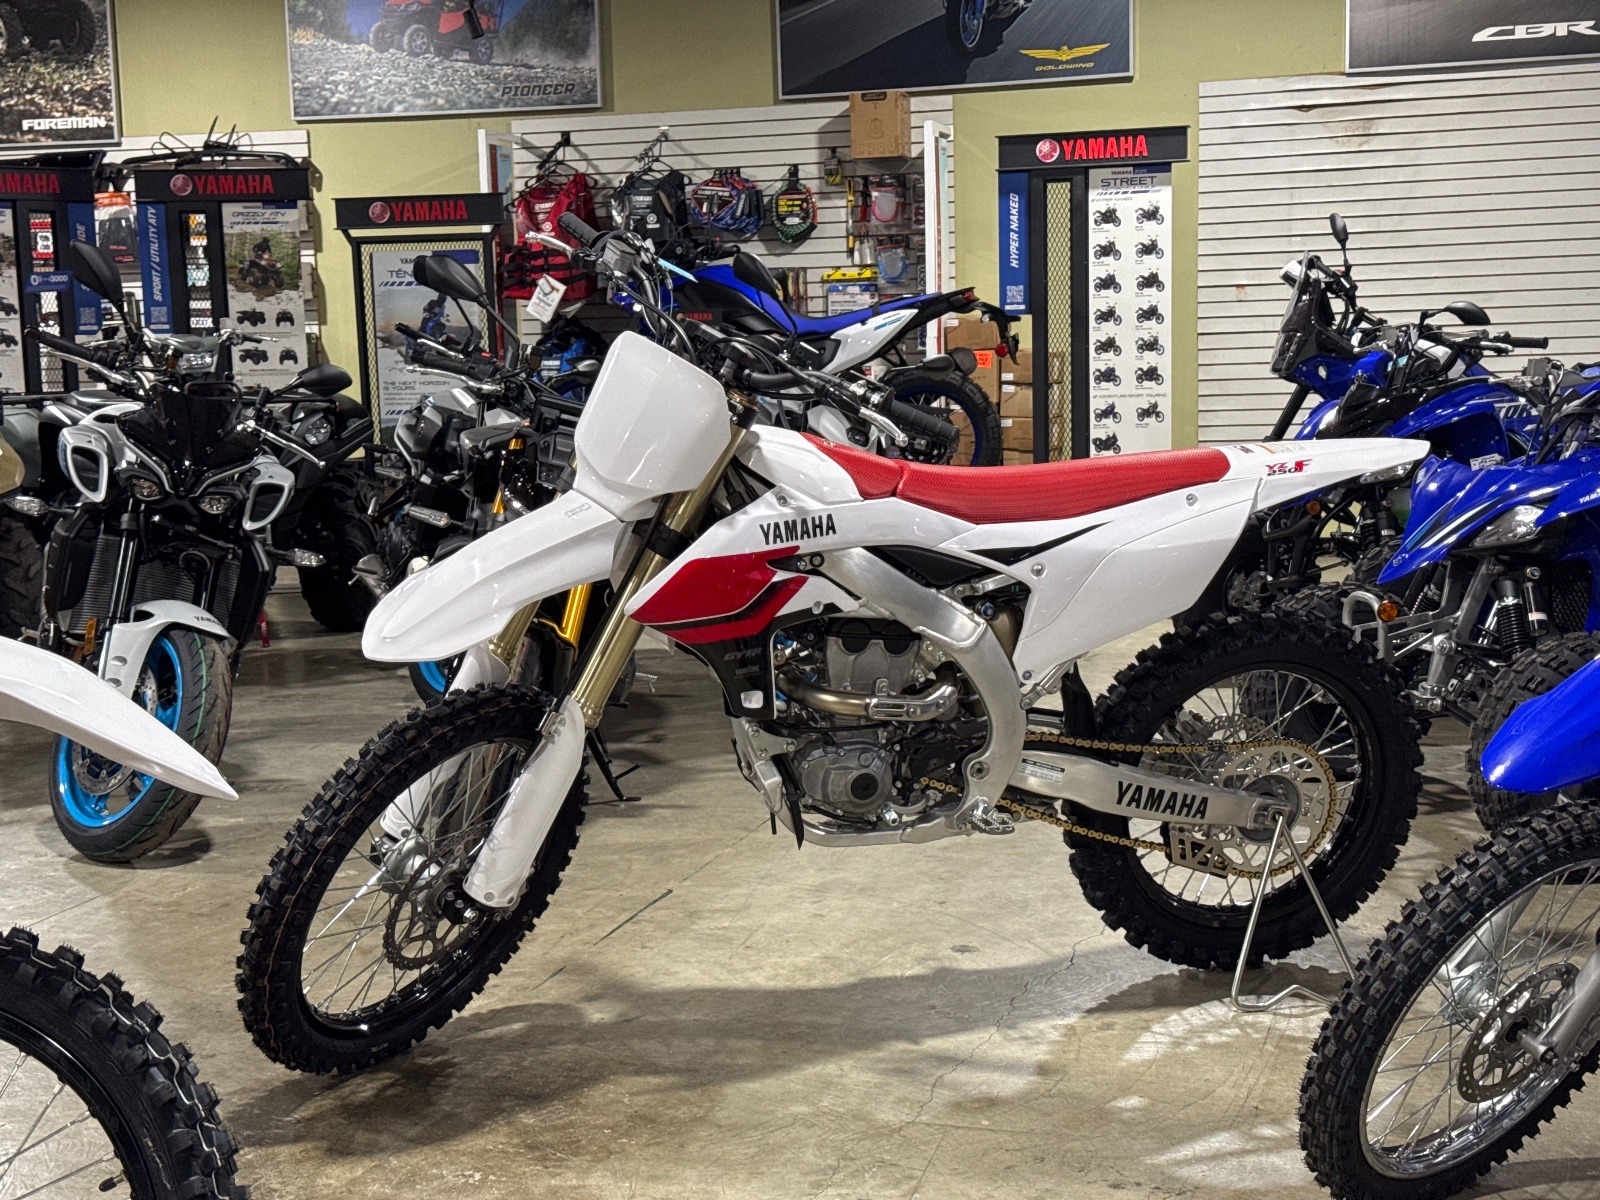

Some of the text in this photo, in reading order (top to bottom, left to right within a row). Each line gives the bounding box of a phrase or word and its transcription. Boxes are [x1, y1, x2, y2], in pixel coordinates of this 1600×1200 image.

[1472, 20, 1600, 42] CBR
[1035, 62, 1095, 71] GOLDWING
[501, 83, 576, 98] PIONEER
[22, 116, 107, 131] FOREMAN
[1061, 135, 1148, 161] YAMAHA
[194, 174, 275, 195] YAMAHA
[1101, 176, 1158, 187] STREET
[147, 206, 157, 225] ATV
[391, 200, 468, 222] YAMAHA
[1009, 193, 1020, 268] HYPER NAKED
[149, 226, 160, 262] UTILITY
[153, 270, 163, 302] SPORT
[759, 513, 837, 546] YAMAHA
[1115, 781, 1209, 820] YAMAHA
